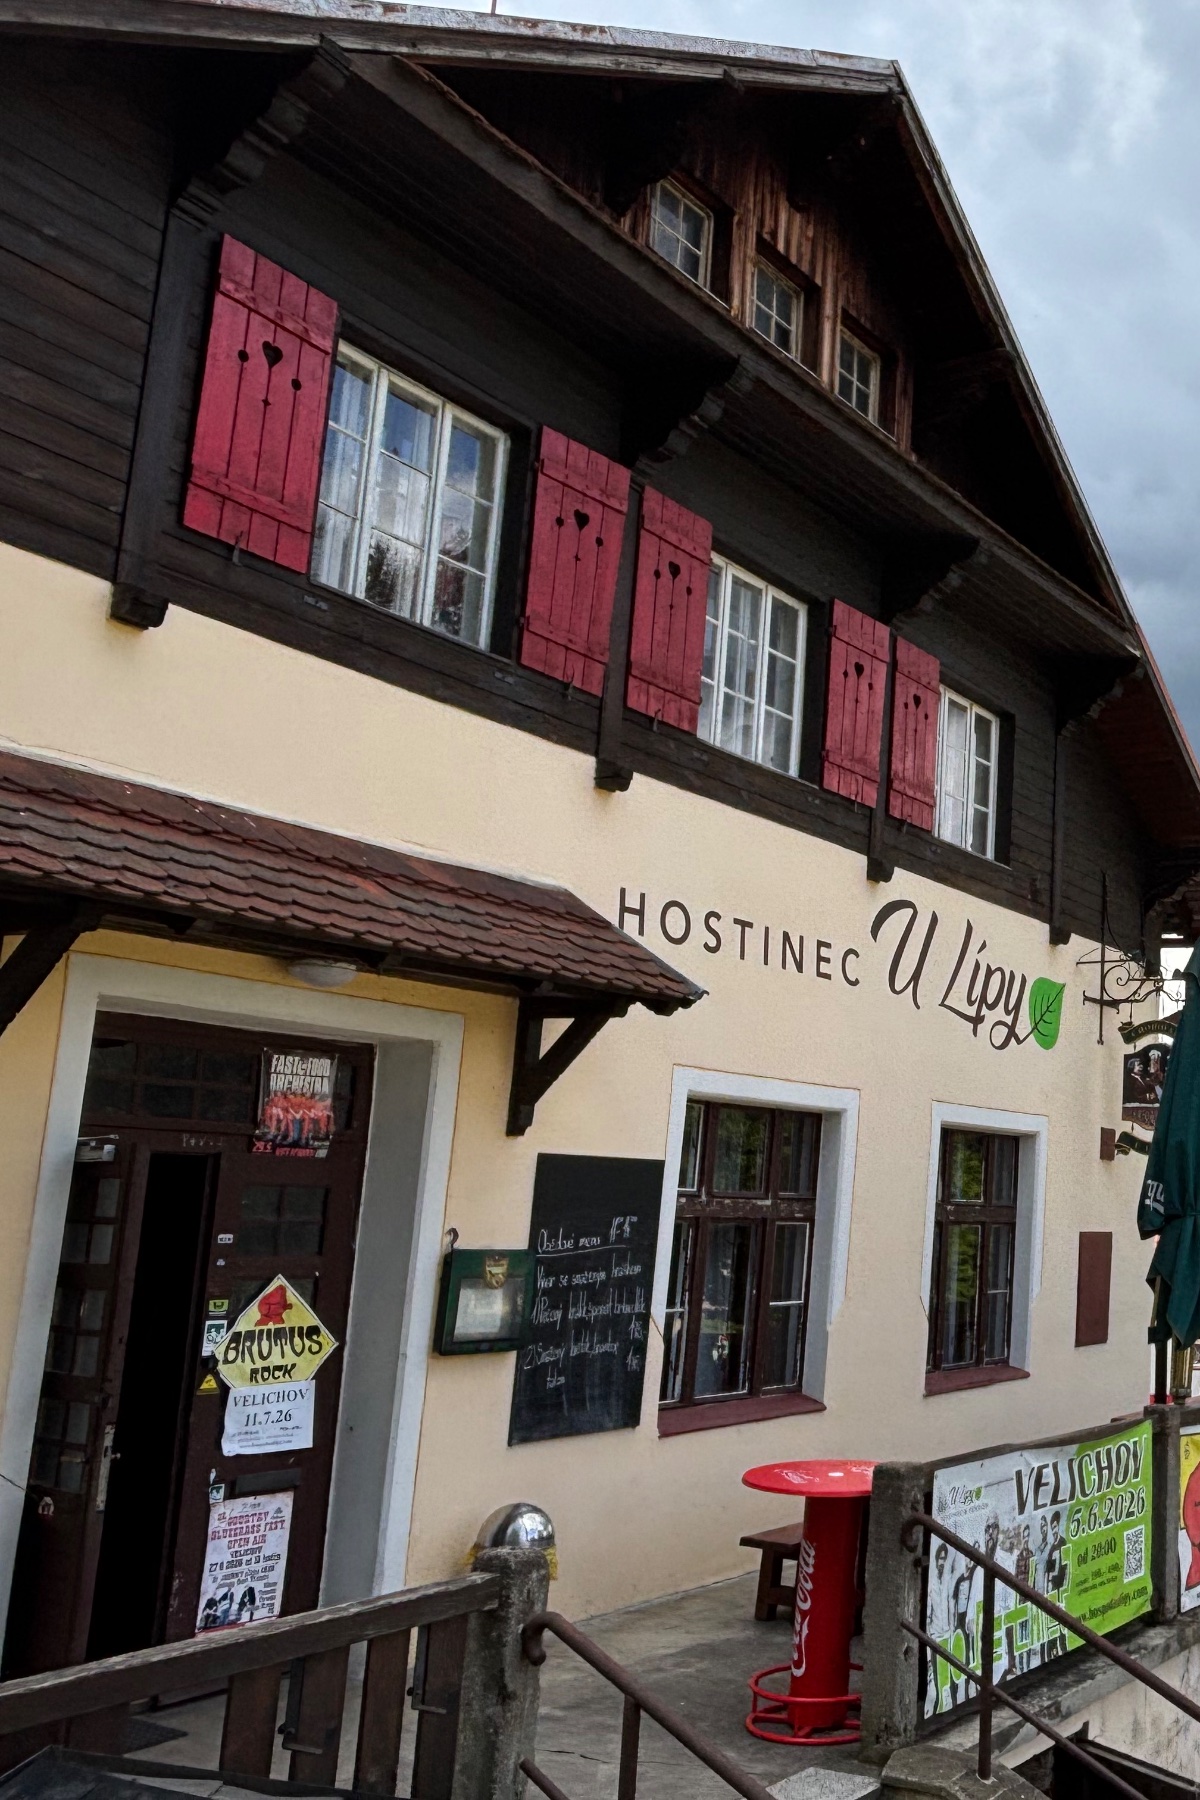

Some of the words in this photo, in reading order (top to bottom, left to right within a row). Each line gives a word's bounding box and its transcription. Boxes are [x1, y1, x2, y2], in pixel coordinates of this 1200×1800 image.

[618, 887, 860, 986] HOSTINEC
[870, 900, 938, 1010] U
[938, 918, 1032, 1051] Lípy
[222, 1324, 323, 1365] BRUTUS
[250, 1363, 297, 1384] ROCK
[233, 1388, 309, 1407] VELICHOV
[244, 1408, 294, 1427] 11.7.26
[1015, 1434, 1147, 1516] VELICHOV
[1069, 1485, 1146, 1539] 5.6.2026
